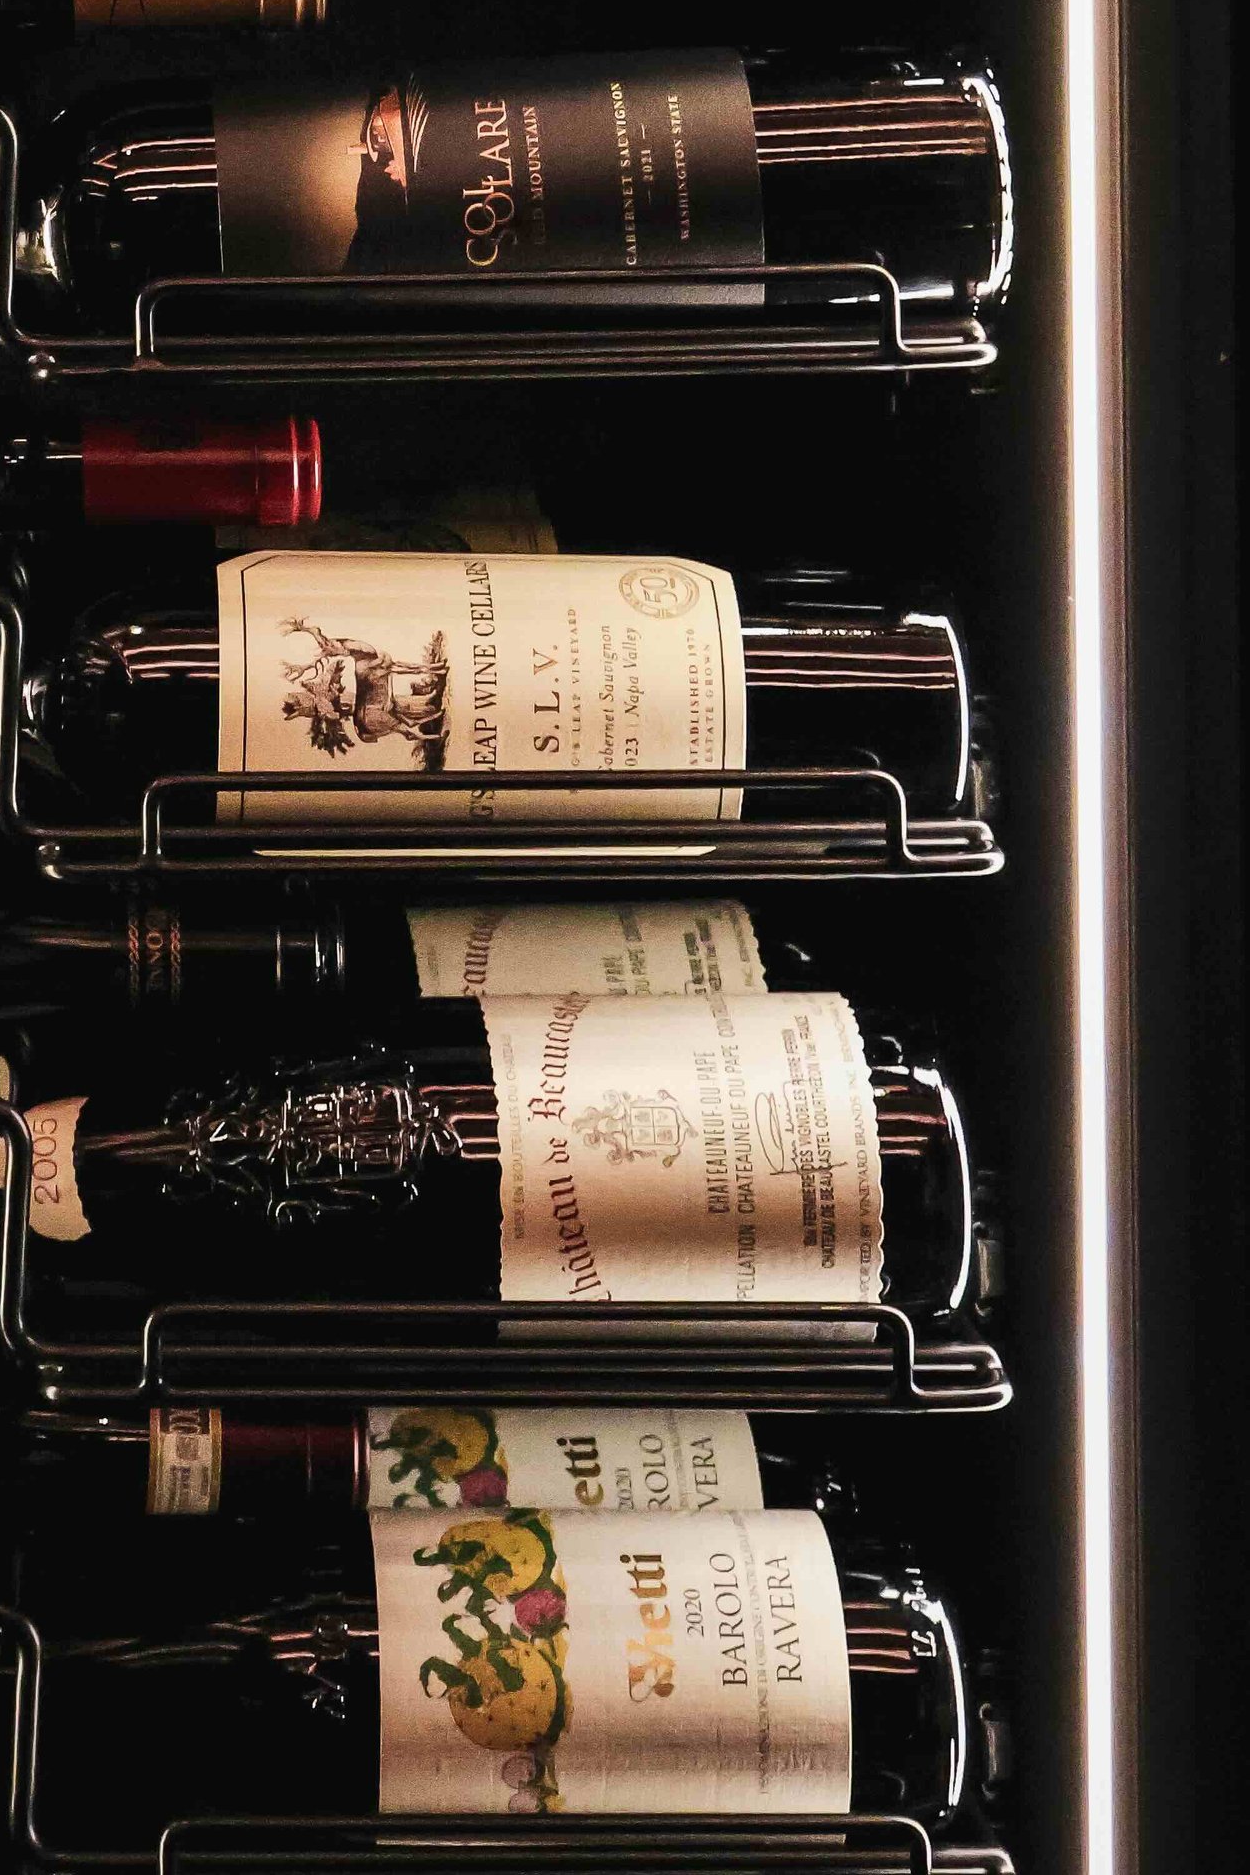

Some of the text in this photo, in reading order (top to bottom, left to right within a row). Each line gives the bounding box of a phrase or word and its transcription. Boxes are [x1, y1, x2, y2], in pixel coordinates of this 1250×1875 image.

[523, 104, 544, 201] MOUNTAIN
[609, 80, 638, 267] CABERNET SAUVIGNON
[463, 560, 496, 637] CELLARS
[472, 643, 498, 710] WINE
[598, 625, 619, 702] Sauvignon
[623, 676, 646, 718] Napa
[720, 1043, 744, 1075] PAPE
[723, 1077, 748, 1099] DU
[32, 1118, 59, 1205] 2005
[544, 1136, 570, 1166] de
[728, 1101, 755, 1215] CHATEAUNEUF
[682, 1588, 705, 1637] 2020
[708, 1552, 749, 1688] BAROLO
[763, 1554, 804, 1684] RAVERA
